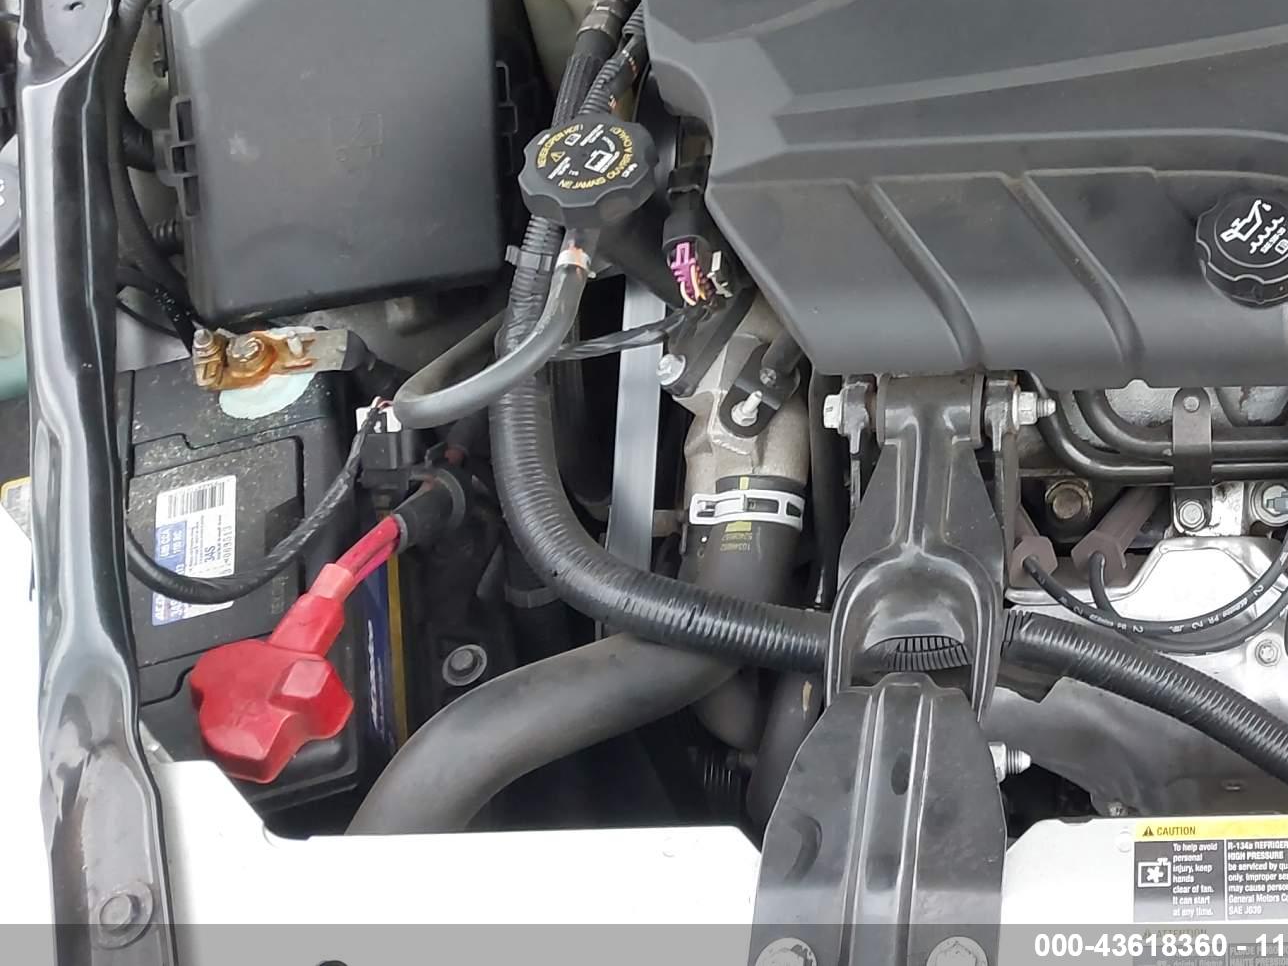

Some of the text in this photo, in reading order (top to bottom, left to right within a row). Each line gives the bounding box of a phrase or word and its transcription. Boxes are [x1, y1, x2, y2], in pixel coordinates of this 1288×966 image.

[1253, 584, 1264, 597] 2
[1132, 625, 1144, 633] 2
[1157, 826, 1196, 836] CAUTION
[1173, 843, 1218, 853] To help avoid
[1227, 841, 1253, 851] R-134a
[1173, 854, 1203, 863] personal
[1227, 851, 1246, 861] HIGH
[1247, 850, 1284, 860] PRESSURE
[1195, 863, 1213, 874] keep
[1228, 862, 1237, 871] be
[1238, 861, 1267, 871] serviced
[1268, 860, 1277, 872] by
[1246, 872, 1277, 883] Improper
[1173, 885, 1191, 894] clear
[1191, 884, 1200, 893] of
[1228, 883, 1243, 893] may
[1244, 883, 1266, 892] cause
[1179, 897, 1192, 905] can
[1194, 895, 1211, 905] start
[1228, 894, 1255, 904] General
[1256, 893, 1280, 903] Motors
[1228, 906, 1244, 916] SAE
